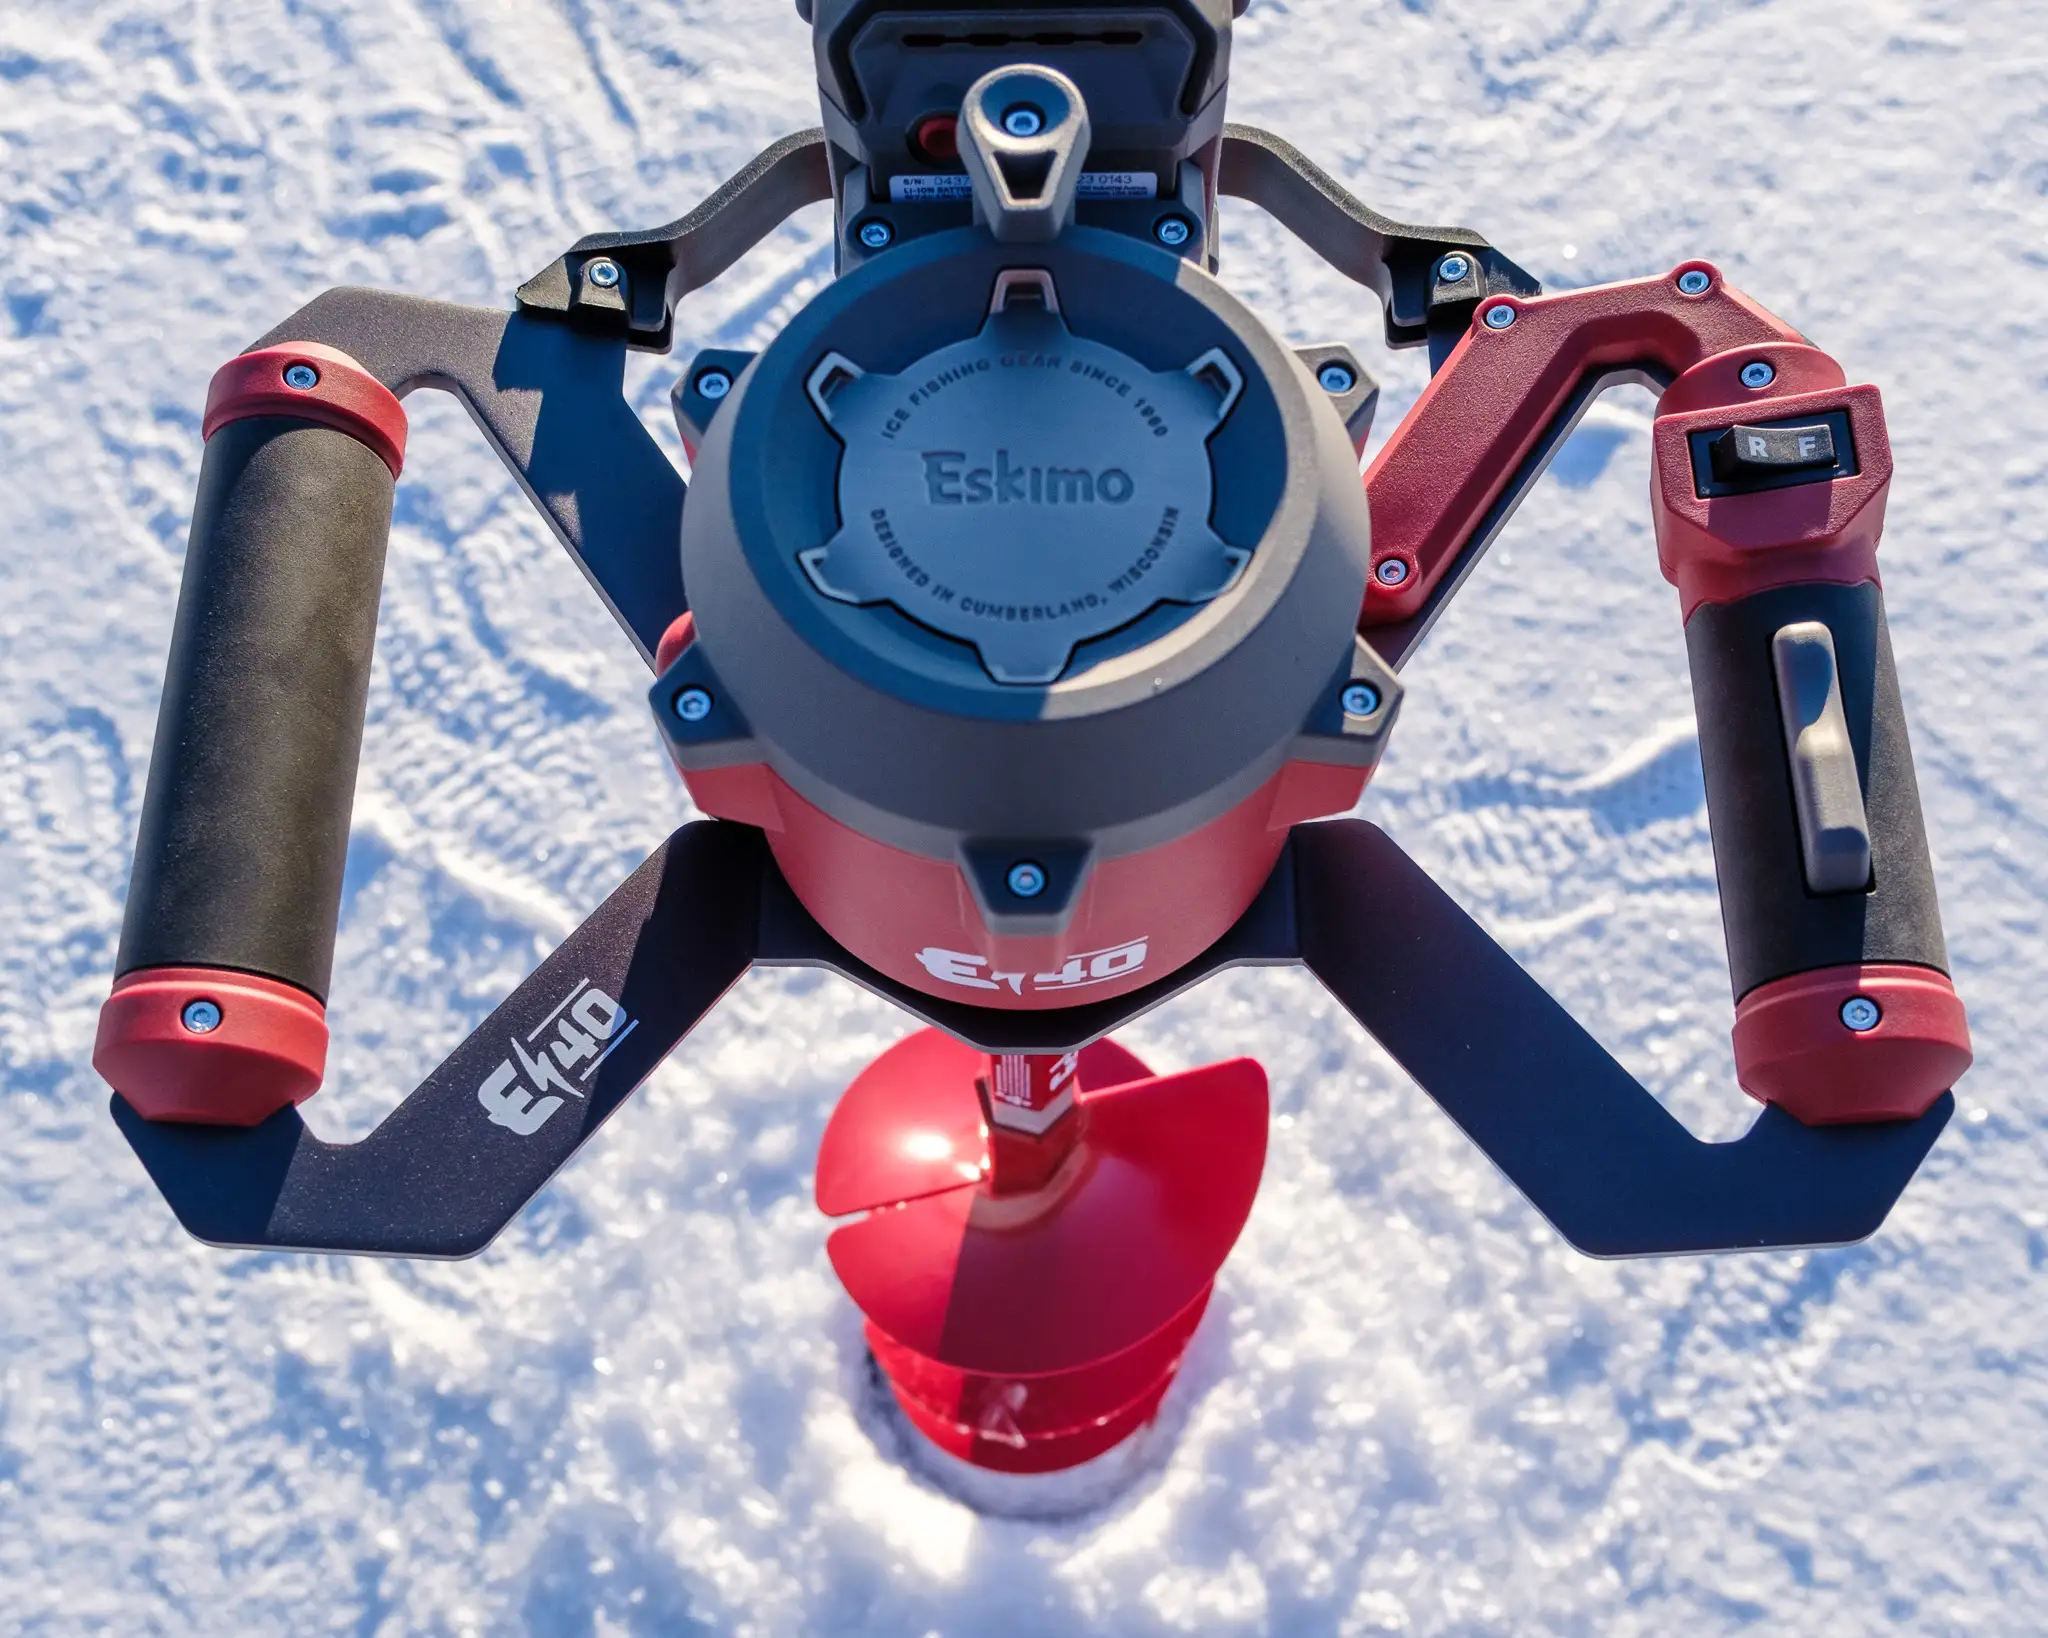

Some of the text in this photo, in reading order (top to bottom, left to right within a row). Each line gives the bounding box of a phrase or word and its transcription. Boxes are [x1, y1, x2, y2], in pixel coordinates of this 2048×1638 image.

[881, 408, 910, 439] ICE
[909, 358, 990, 406] FISHING
[1000, 352, 1060, 369] GEAR
[1069, 360, 1132, 398] SINCE
[921, 449, 1135, 505] Eskimo
[1748, 436, 1816, 458] R F
[870, 506, 1180, 622] DESIGNED IN CUMBERLAND, WISCONSIN
